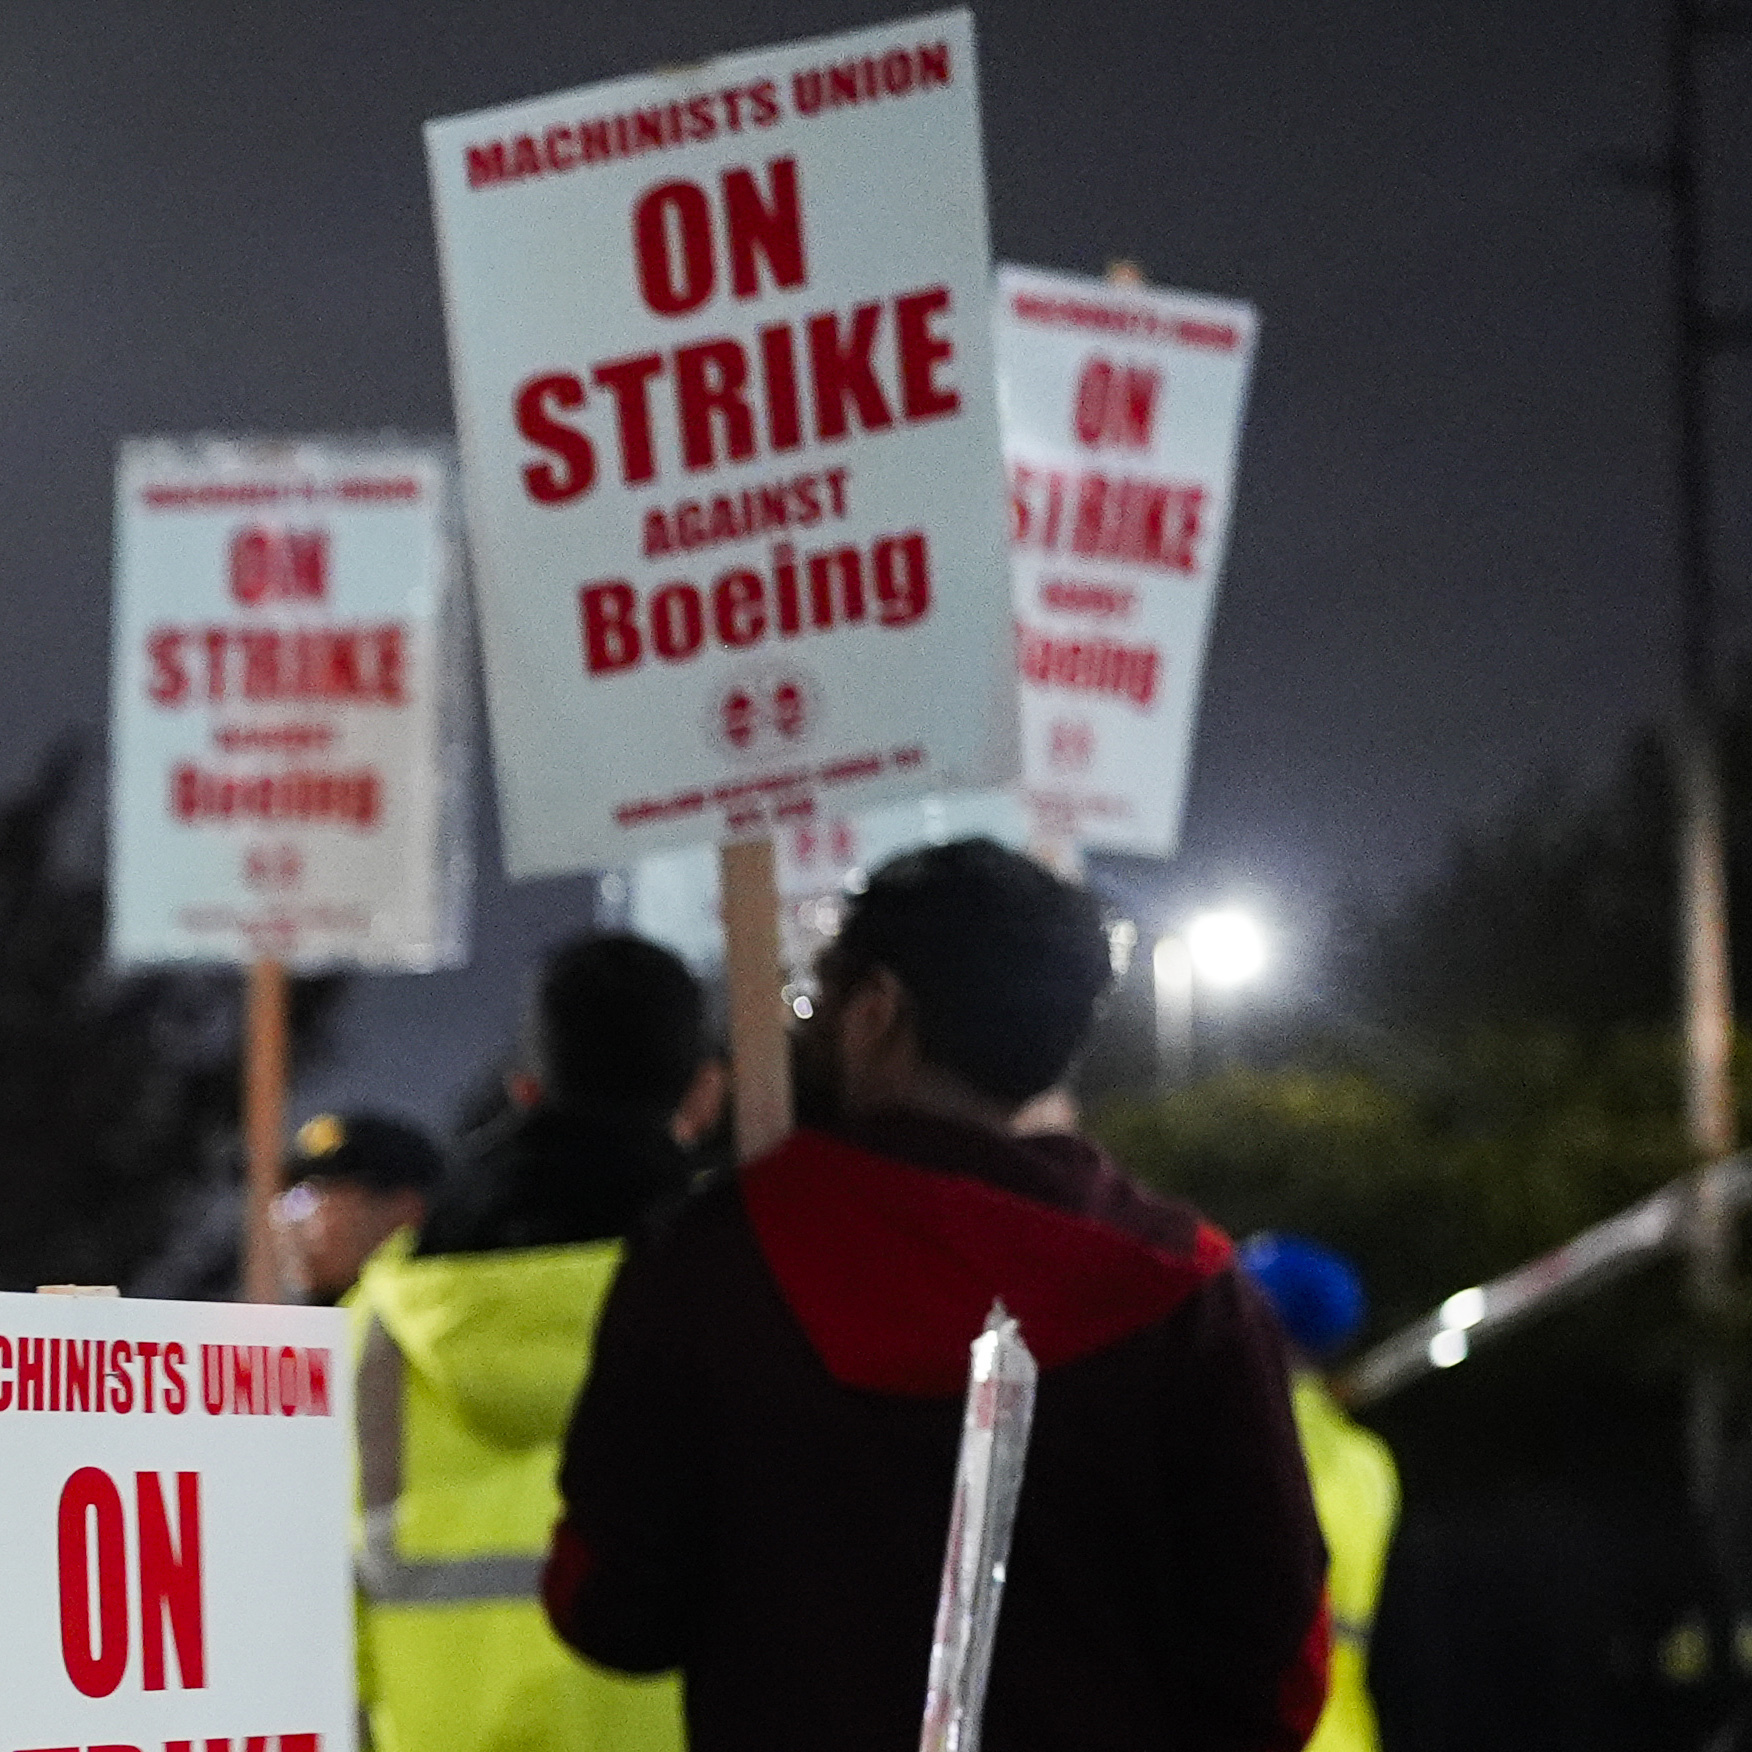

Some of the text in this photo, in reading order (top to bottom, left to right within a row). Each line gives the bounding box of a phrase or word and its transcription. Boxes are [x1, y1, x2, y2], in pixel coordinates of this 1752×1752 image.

[464, 42, 951, 190] MACHINISTS UNION
[630, 155, 808, 322] ON
[510, 284, 963, 508] STRIKE
[640, 466, 850, 560] AGAINST
[576, 530, 934, 680] Boeing
[199, 1343, 333, 1418] UNION
[57, 1465, 208, 1699] ON
